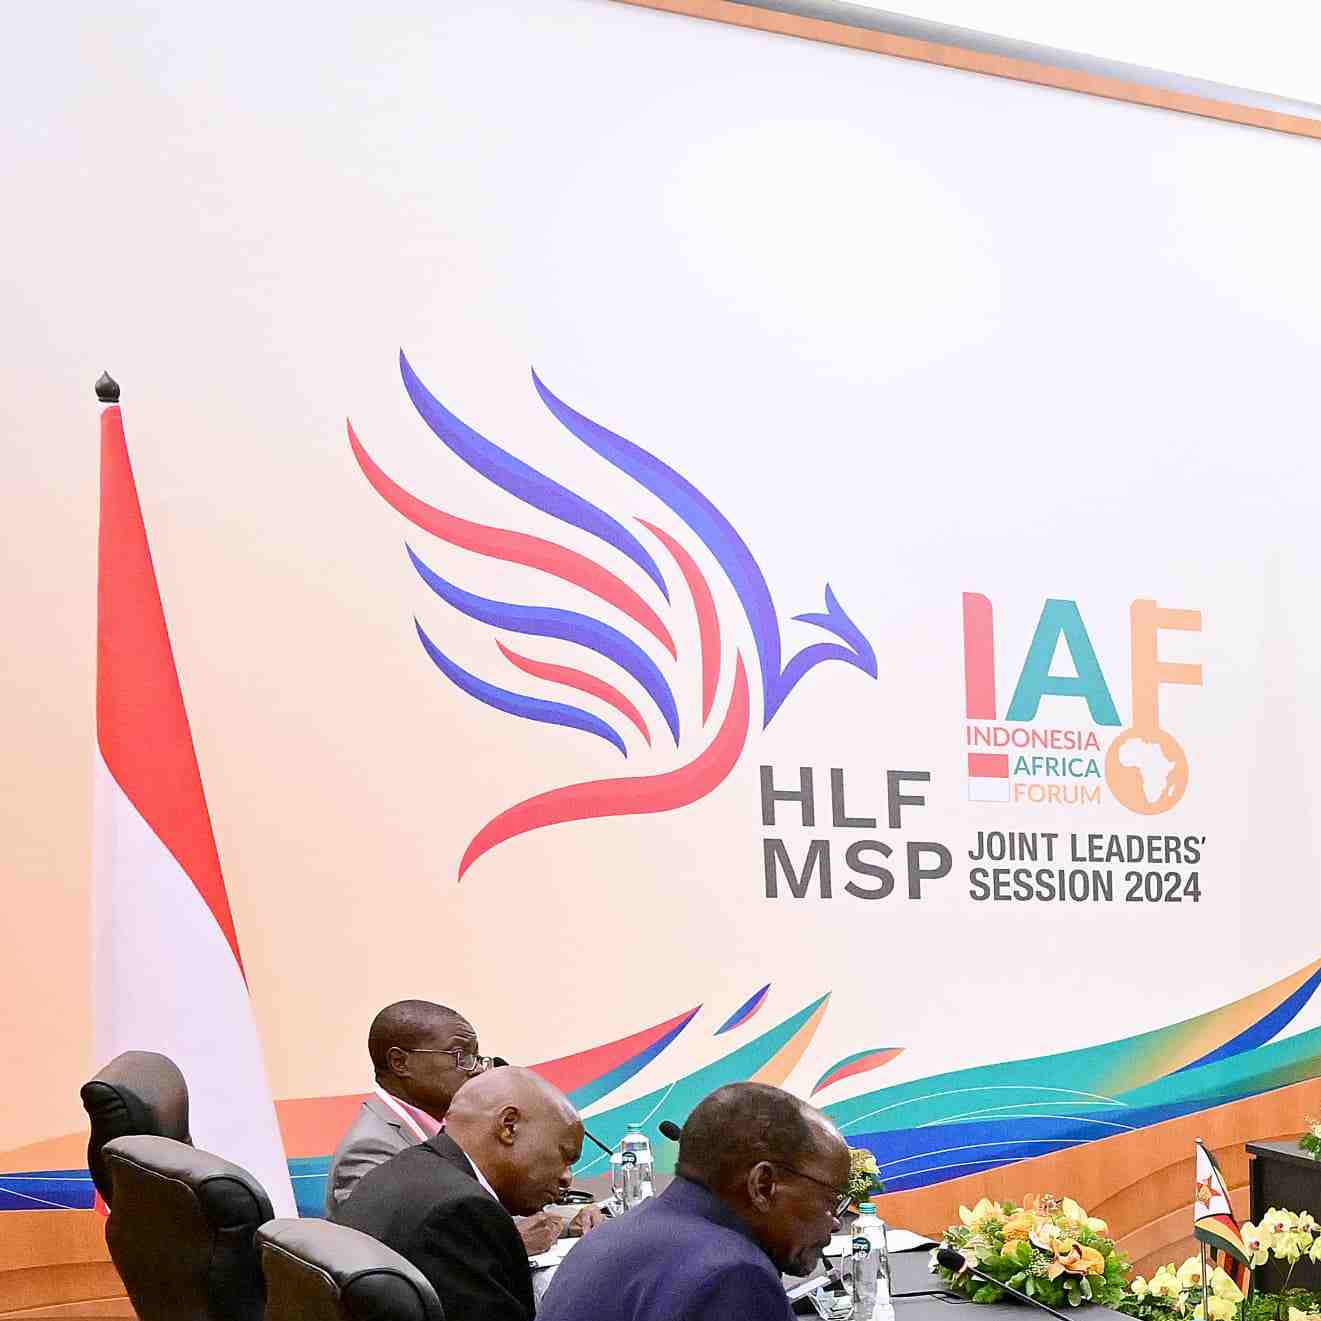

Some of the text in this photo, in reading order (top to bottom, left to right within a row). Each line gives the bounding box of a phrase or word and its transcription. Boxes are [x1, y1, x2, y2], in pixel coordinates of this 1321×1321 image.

[962, 591, 1203, 727] IAF
[966, 725, 1101, 752] INDONESIA
[1013, 755, 1101, 779] AFRICA
[759, 765, 932, 830] HLF
[1014, 783, 1102, 806] FORUM
[968, 831, 1207, 864] JOINT LEADERS'
[762, 837, 953, 901] MSP
[969, 867, 1202, 904] SESSION 2024
